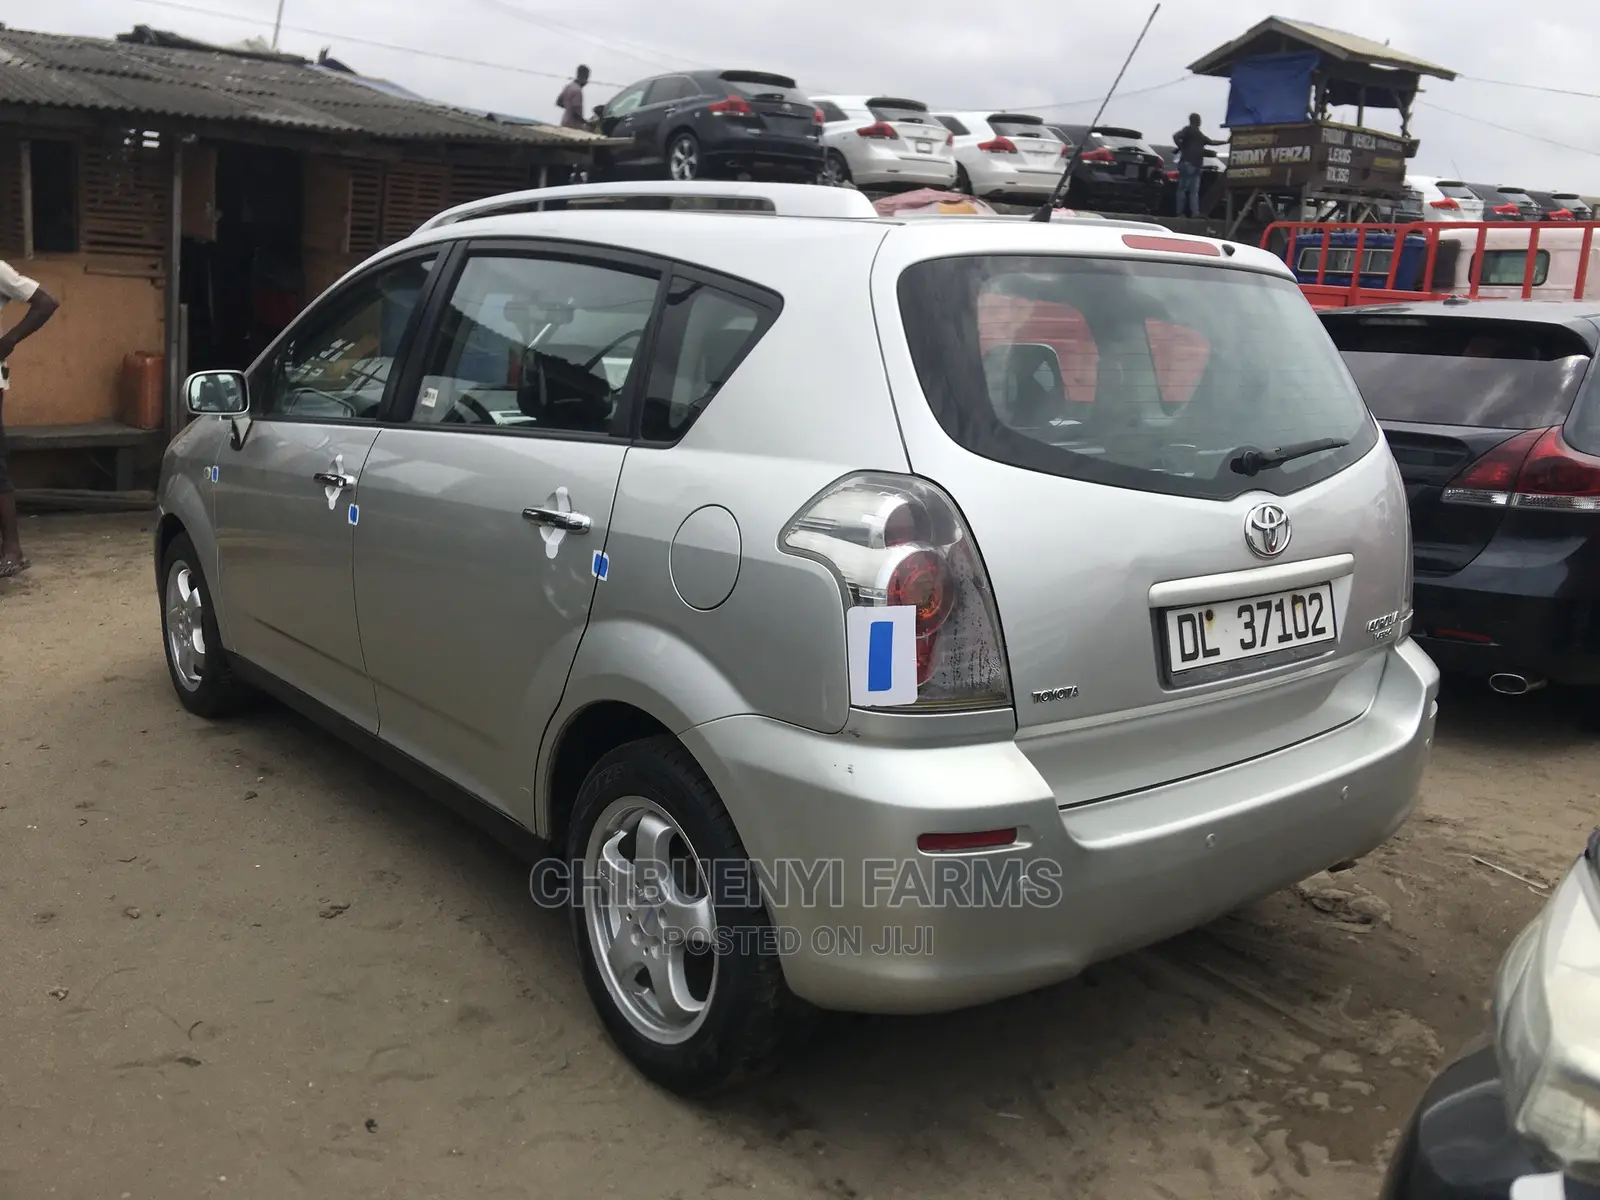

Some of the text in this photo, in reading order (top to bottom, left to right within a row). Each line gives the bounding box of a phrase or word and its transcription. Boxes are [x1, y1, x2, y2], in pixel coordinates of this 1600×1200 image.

[1321, 128, 1347, 145] FRIDAY
[1352, 132, 1376, 150] VENZA
[1231, 146, 1311, 165] FRIDAY VENZA
[1328, 148, 1352, 164] LEXUS
[1177, 592, 1326, 663] DL 37102
[1032, 685, 1079, 704] TOYOTA
